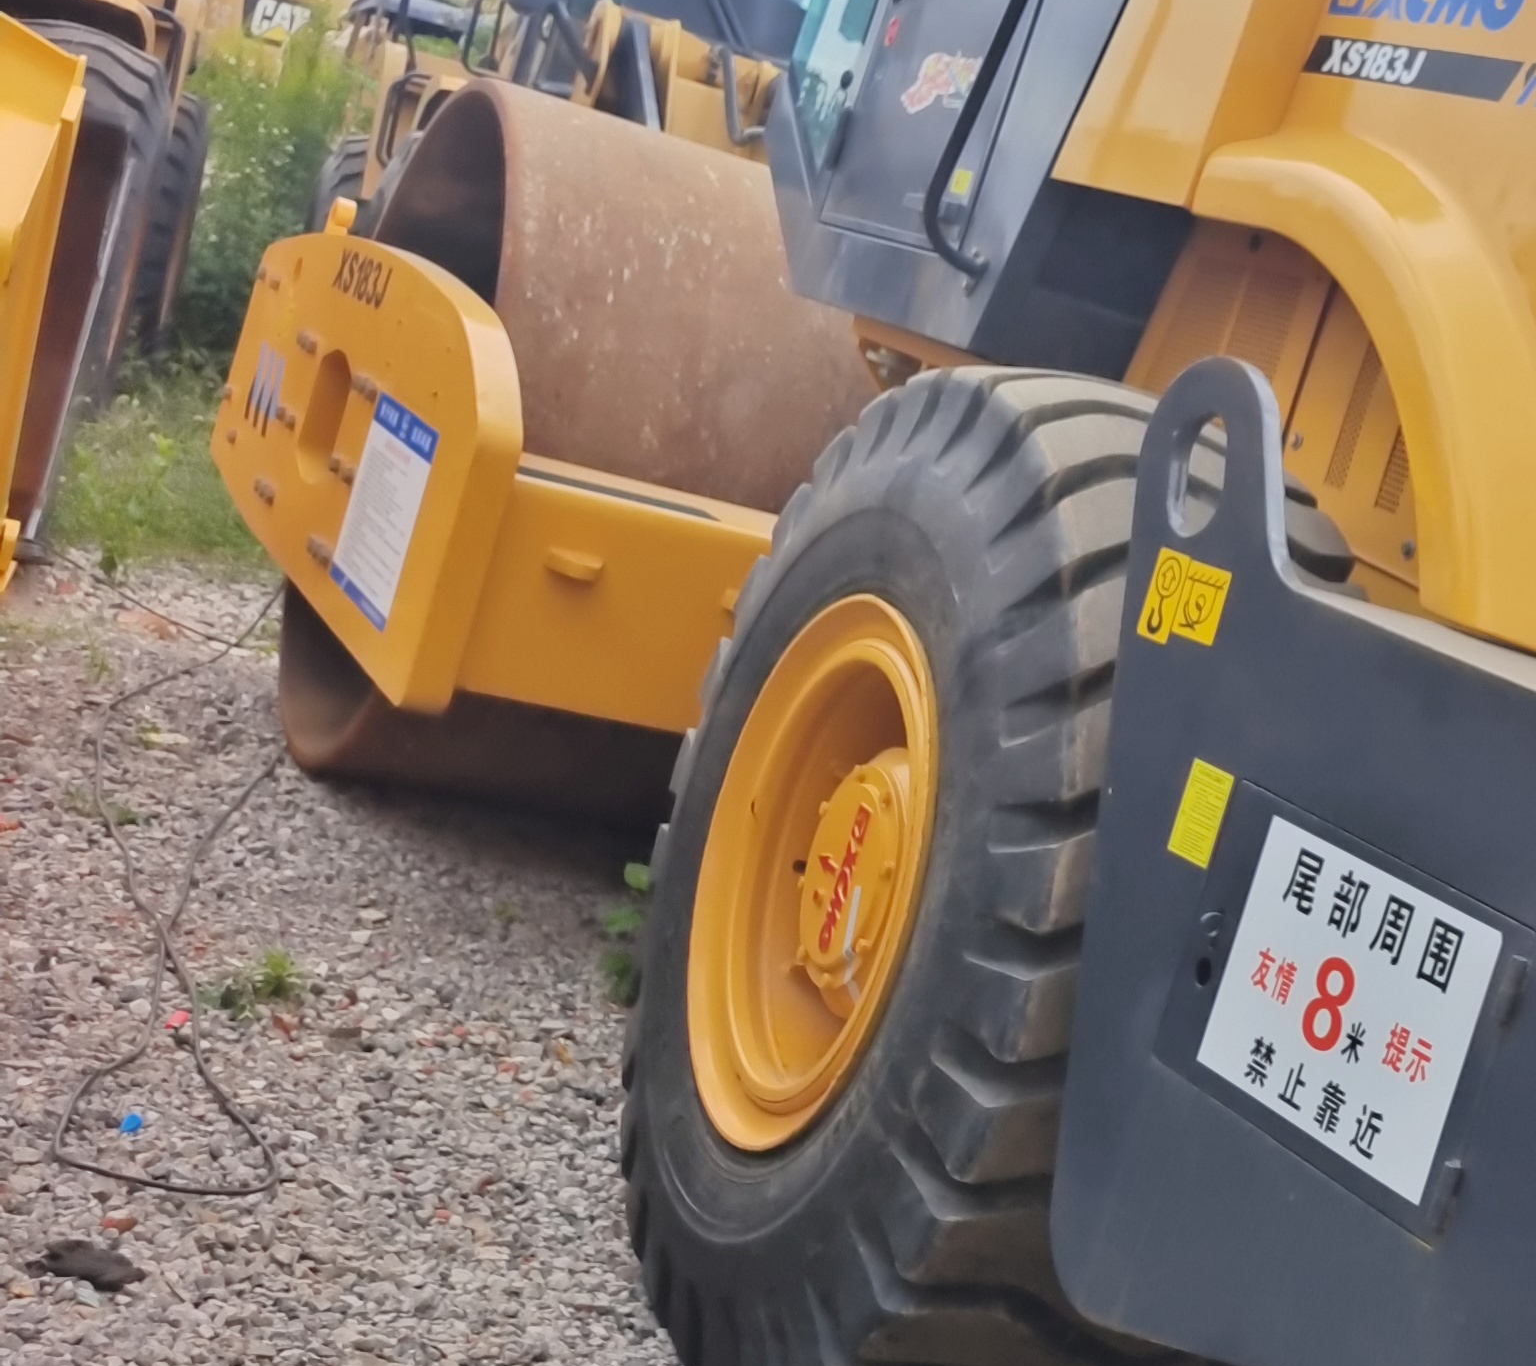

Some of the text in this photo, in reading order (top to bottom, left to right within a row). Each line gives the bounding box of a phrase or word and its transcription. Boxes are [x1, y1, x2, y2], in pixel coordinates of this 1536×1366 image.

[1321, 38, 1428, 85] XS183J
[331, 247, 393, 310] XS183J
[1283, 848, 1466, 994] 尾部周围
[1250, 947, 1299, 1006] 友情
[1381, 1022, 1434, 1084] 提示
[1243, 1036, 1386, 1161] 禁止靠近
